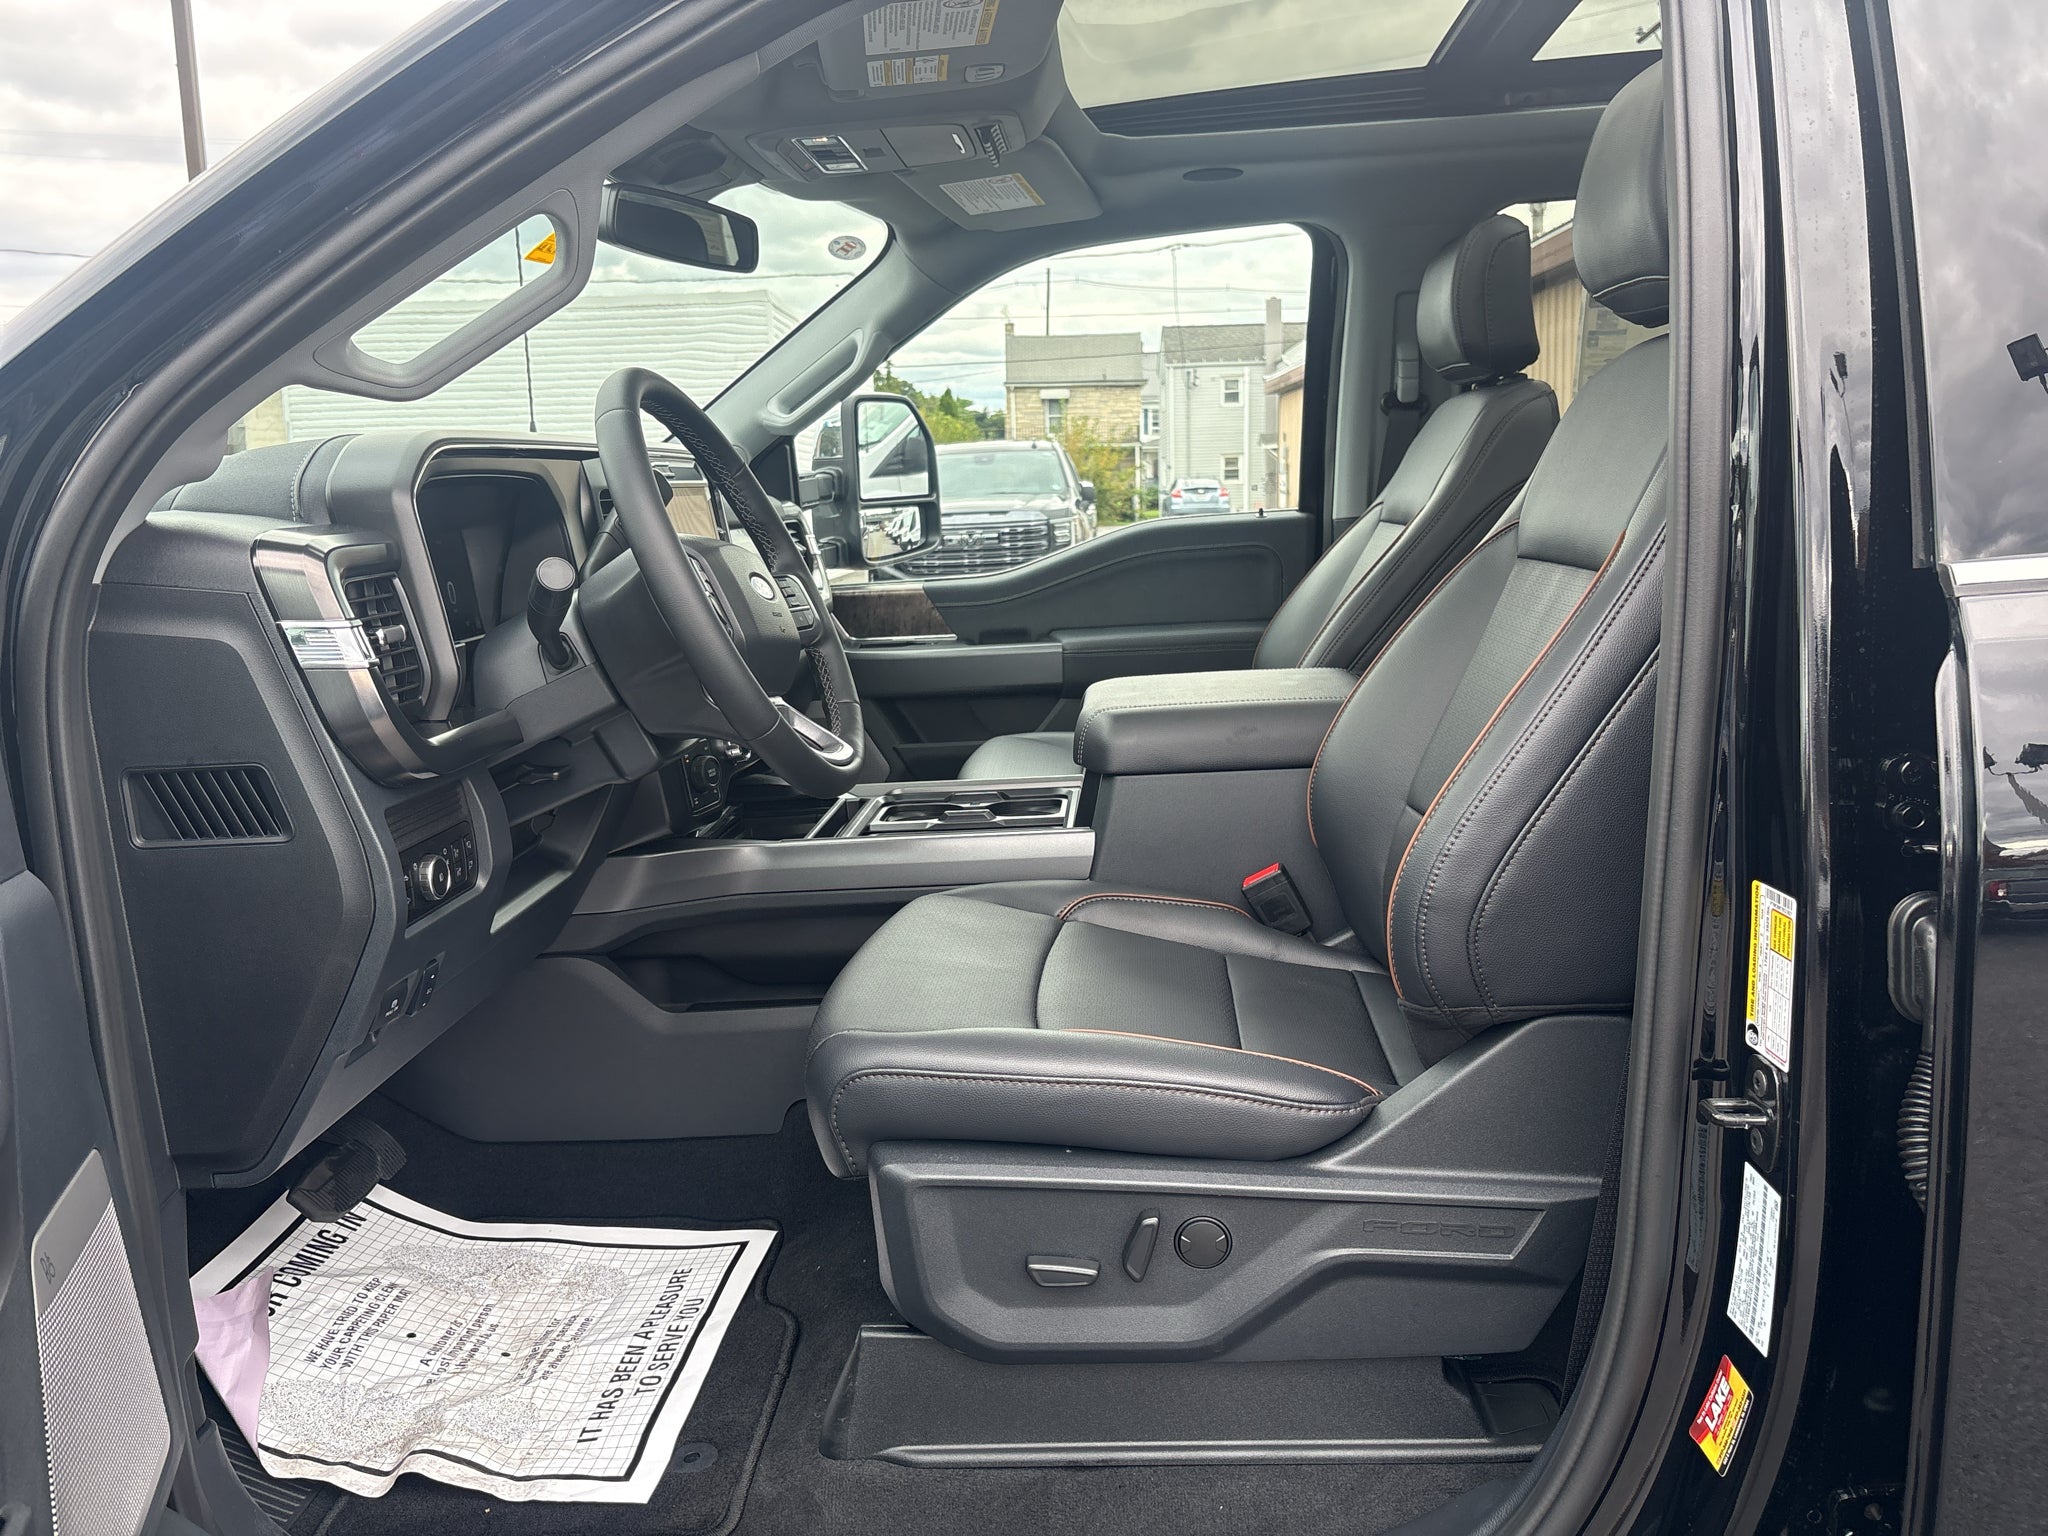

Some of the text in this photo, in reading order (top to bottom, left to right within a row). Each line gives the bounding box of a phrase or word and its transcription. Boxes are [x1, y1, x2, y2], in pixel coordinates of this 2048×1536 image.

[273, 1229, 349, 1287] COMING
[335, 1211, 367, 1232] IN
[1363, 1219, 1515, 1238] FORD
[304, 1277, 383, 1364] WE HAVE TRIED TO KEEP
[320, 1281, 399, 1370] YOUR CARPETING CLEAN
[340, 1343, 365, 1369] WITH
[377, 1303, 400, 1328] PAPER
[472, 1304, 496, 1329] person
[633, 1298, 705, 1396] TO SERVE YOU
[420, 1358, 433, 1367] A
[577, 1267, 693, 1443] IT HAS BEEN A PLEASURE
[1705, 1375, 1730, 1432] LAKE
